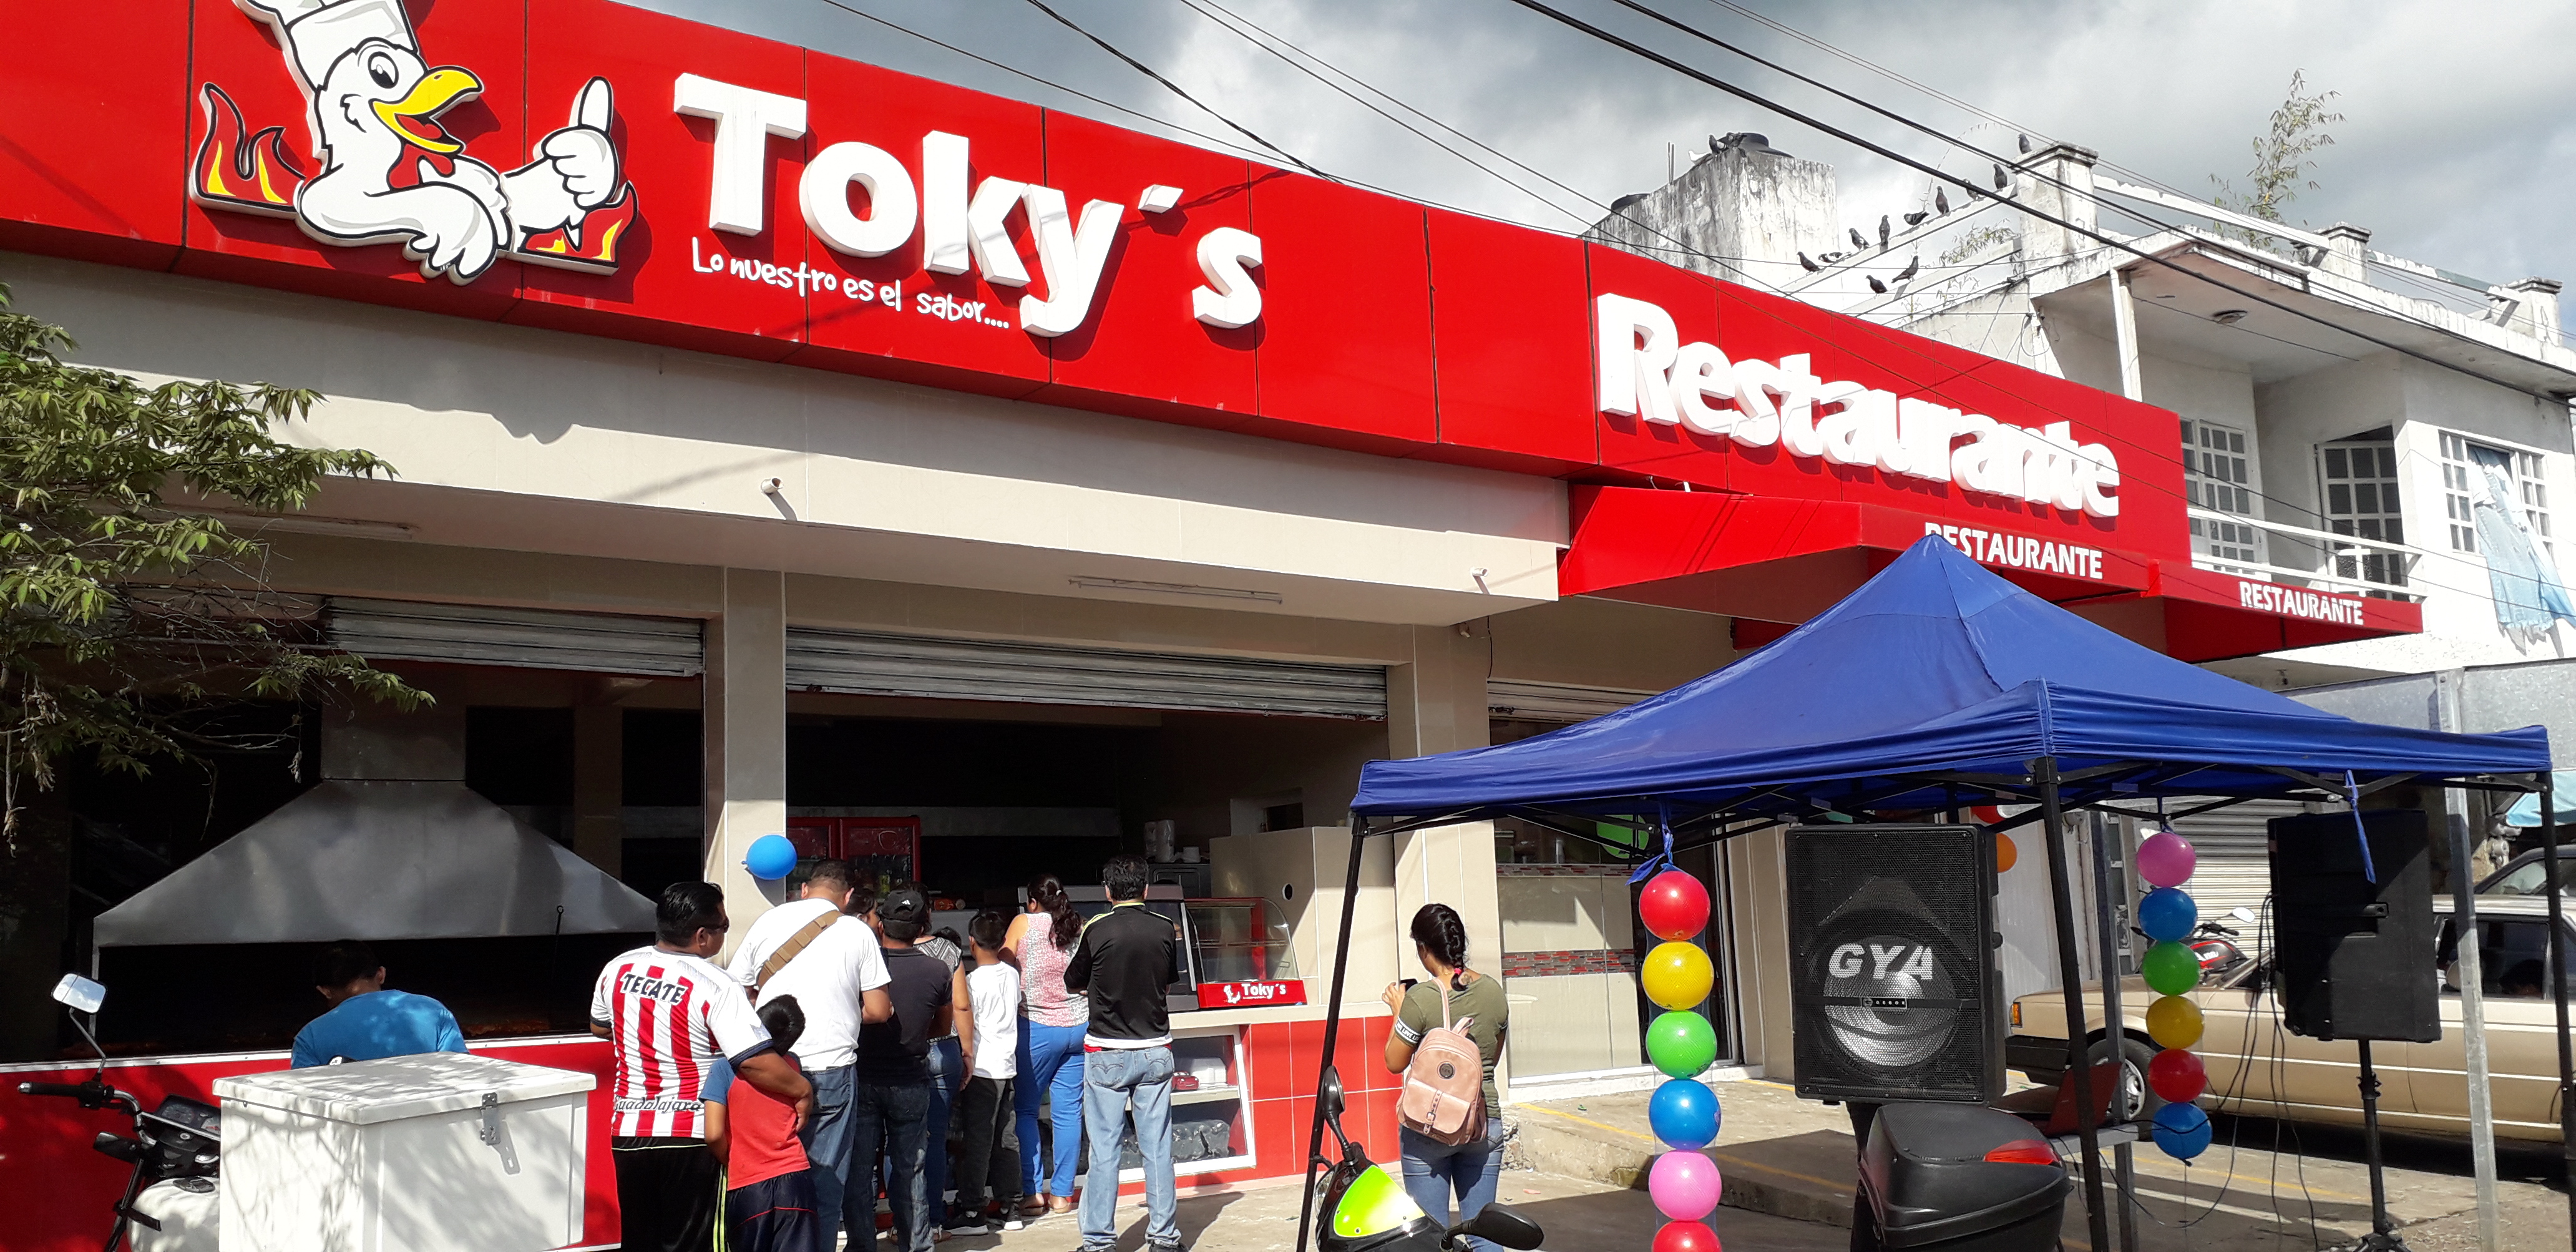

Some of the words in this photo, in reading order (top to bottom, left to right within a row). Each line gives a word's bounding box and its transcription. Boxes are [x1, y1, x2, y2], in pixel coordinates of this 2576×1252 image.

[692, 237, 724, 273] Lo
[730, 258, 837, 297] nuestro
[843, 278, 874, 301] es
[880, 279, 901, 311] el
[1597, 293, 2120, 518] Restaurante
[2239, 581, 2364, 625] RESTAURANTE
[1828, 943, 1933, 980] GYA
[623, 973, 686, 1004] TECATE
